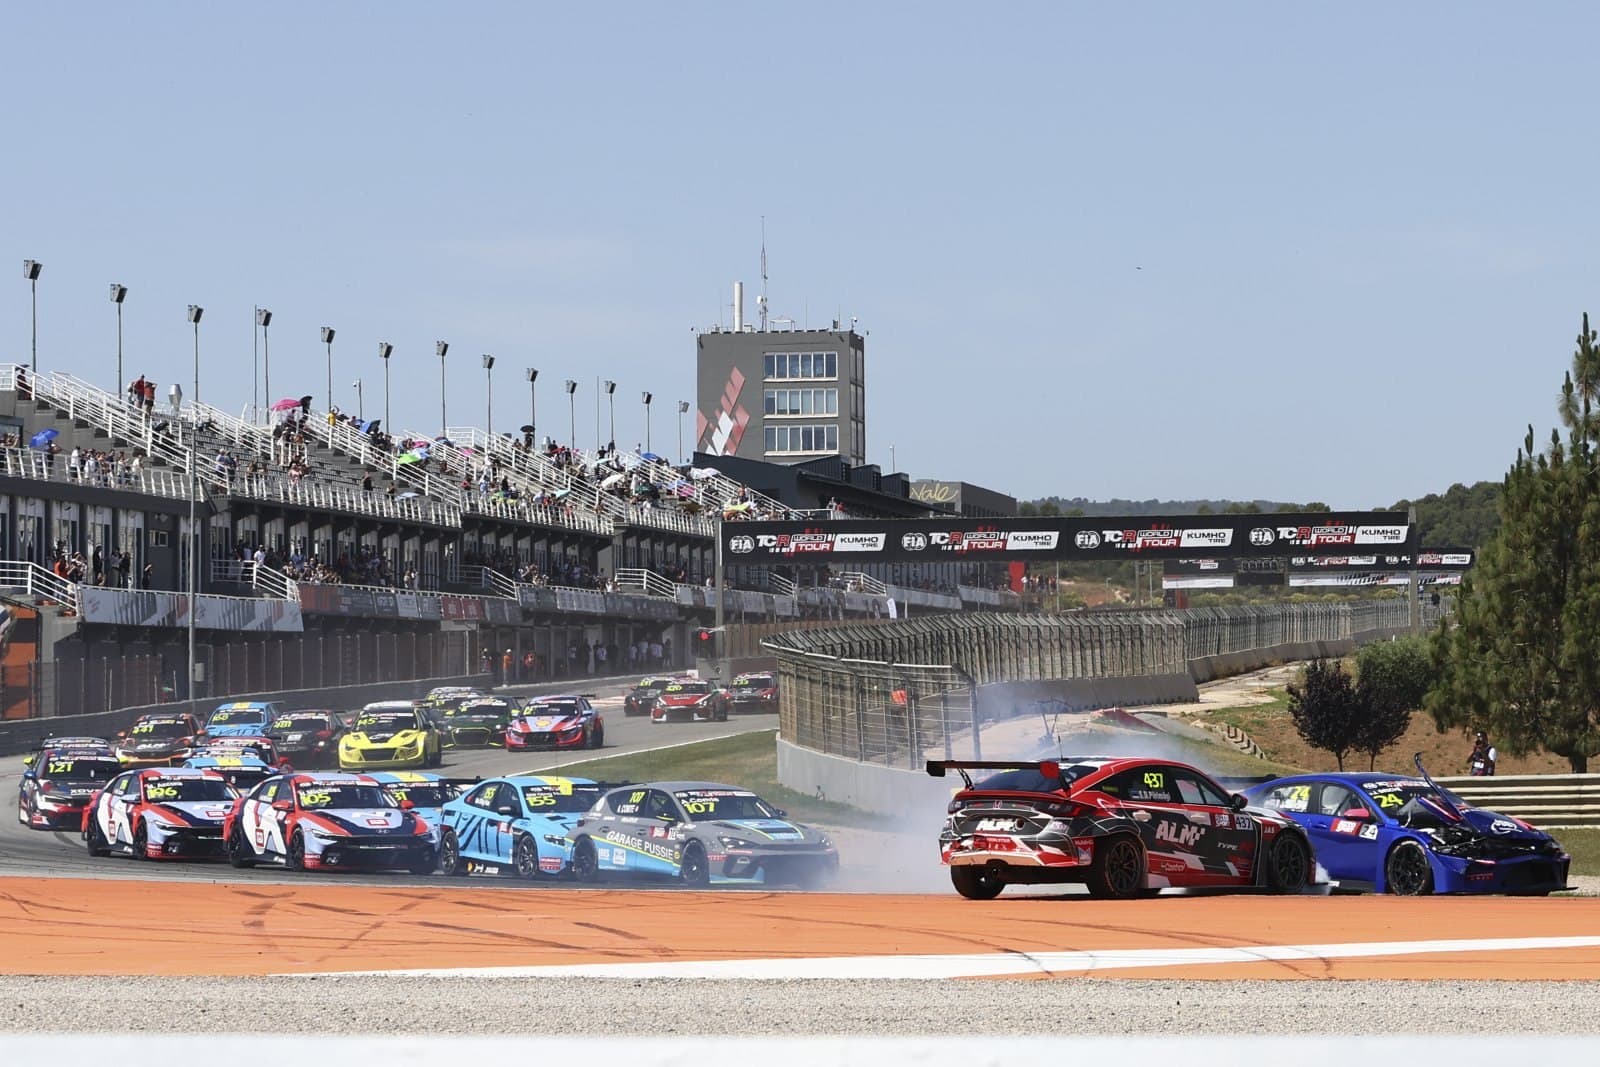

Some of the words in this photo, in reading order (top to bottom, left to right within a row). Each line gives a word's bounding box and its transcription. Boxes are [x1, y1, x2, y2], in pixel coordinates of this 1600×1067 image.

[929, 532, 963, 545] TCR
[1102, 530, 1136, 543] TCR
[1251, 531, 1273, 543] FIA
[1276, 527, 1311, 539] TCR
[1318, 535, 1353, 543] TOUR
[731, 538, 752, 551] FIA
[756, 535, 791, 548] TCR
[797, 543, 831, 551] TOUR
[903, 536, 925, 548] FIA
[1076, 535, 1099, 546] FIA
[1144, 772, 1164, 788] 437
[302, 792, 332, 805] 105
[1290, 785, 1312, 801] 24
[1373, 793, 1404, 808] 24
[684, 802, 716, 814] 107
[1361, 824, 1377, 837] 24
[606, 830, 643, 850] GARAGE
[643, 841, 674, 860] PUSSIE
[1217, 841, 1238, 851] TYPE
